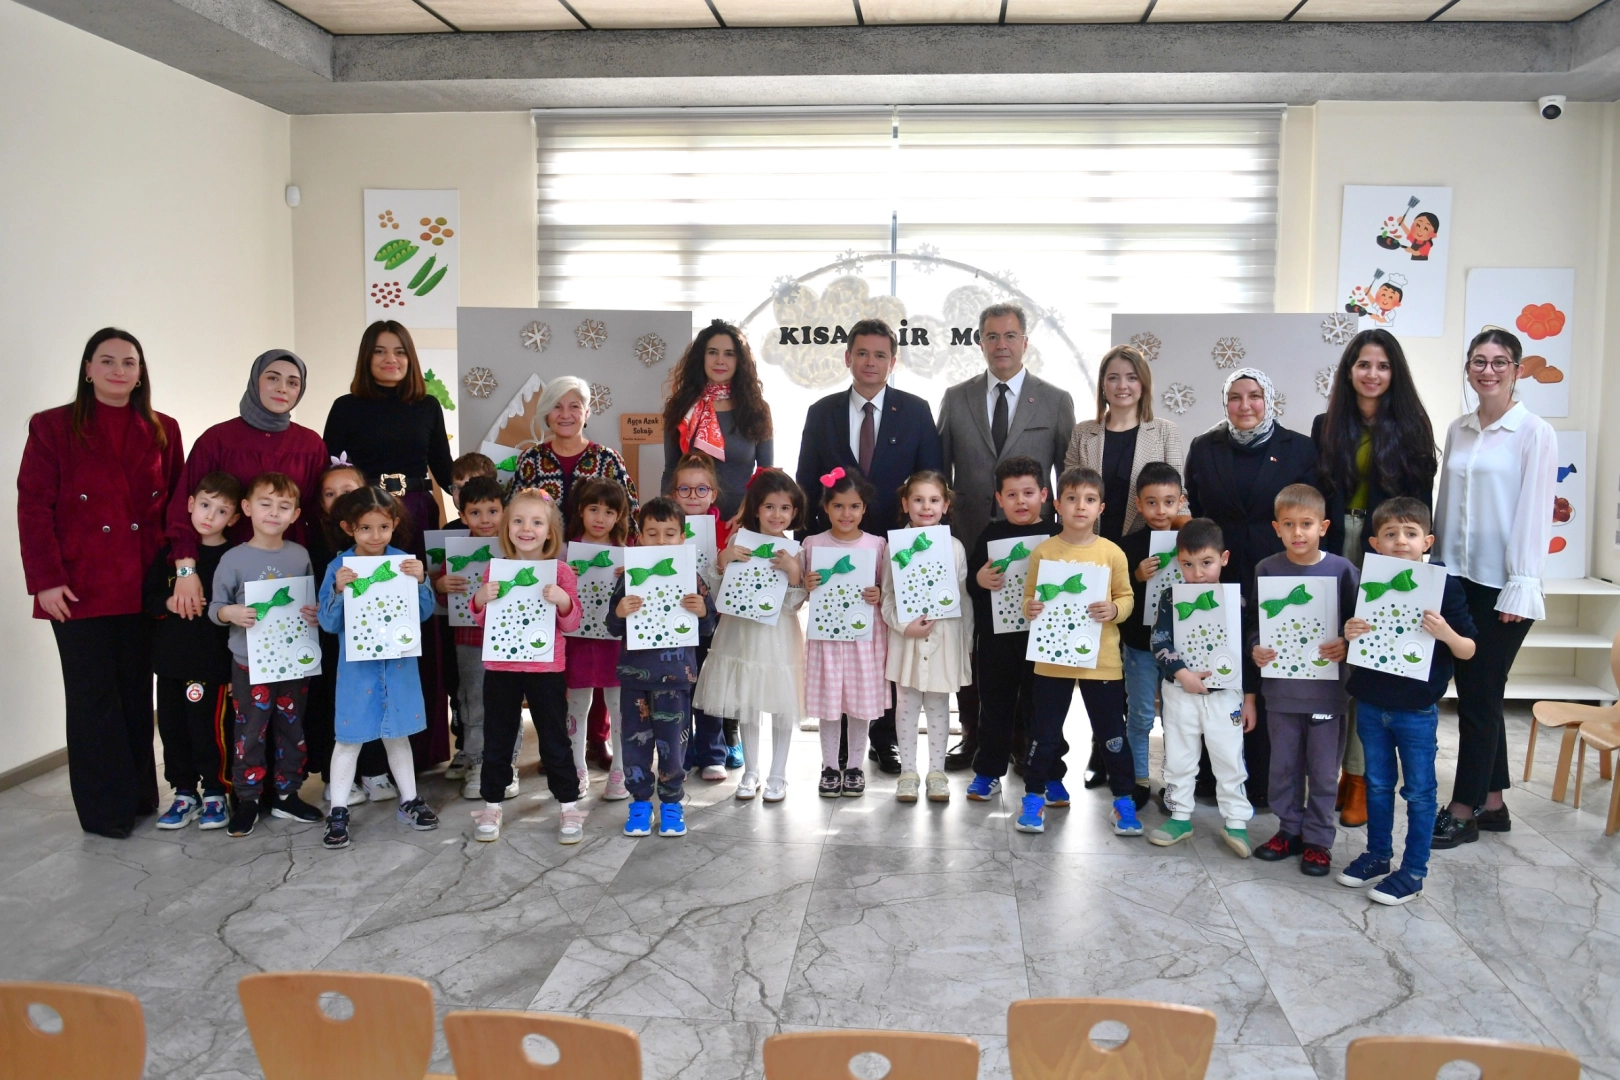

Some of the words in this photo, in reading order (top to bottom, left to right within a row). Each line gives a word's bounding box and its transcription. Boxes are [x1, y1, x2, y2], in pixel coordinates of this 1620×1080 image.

[898, 319, 930, 346] İR
[627, 417, 642, 426] Ayça
[633, 427, 653, 436] Sokağı
